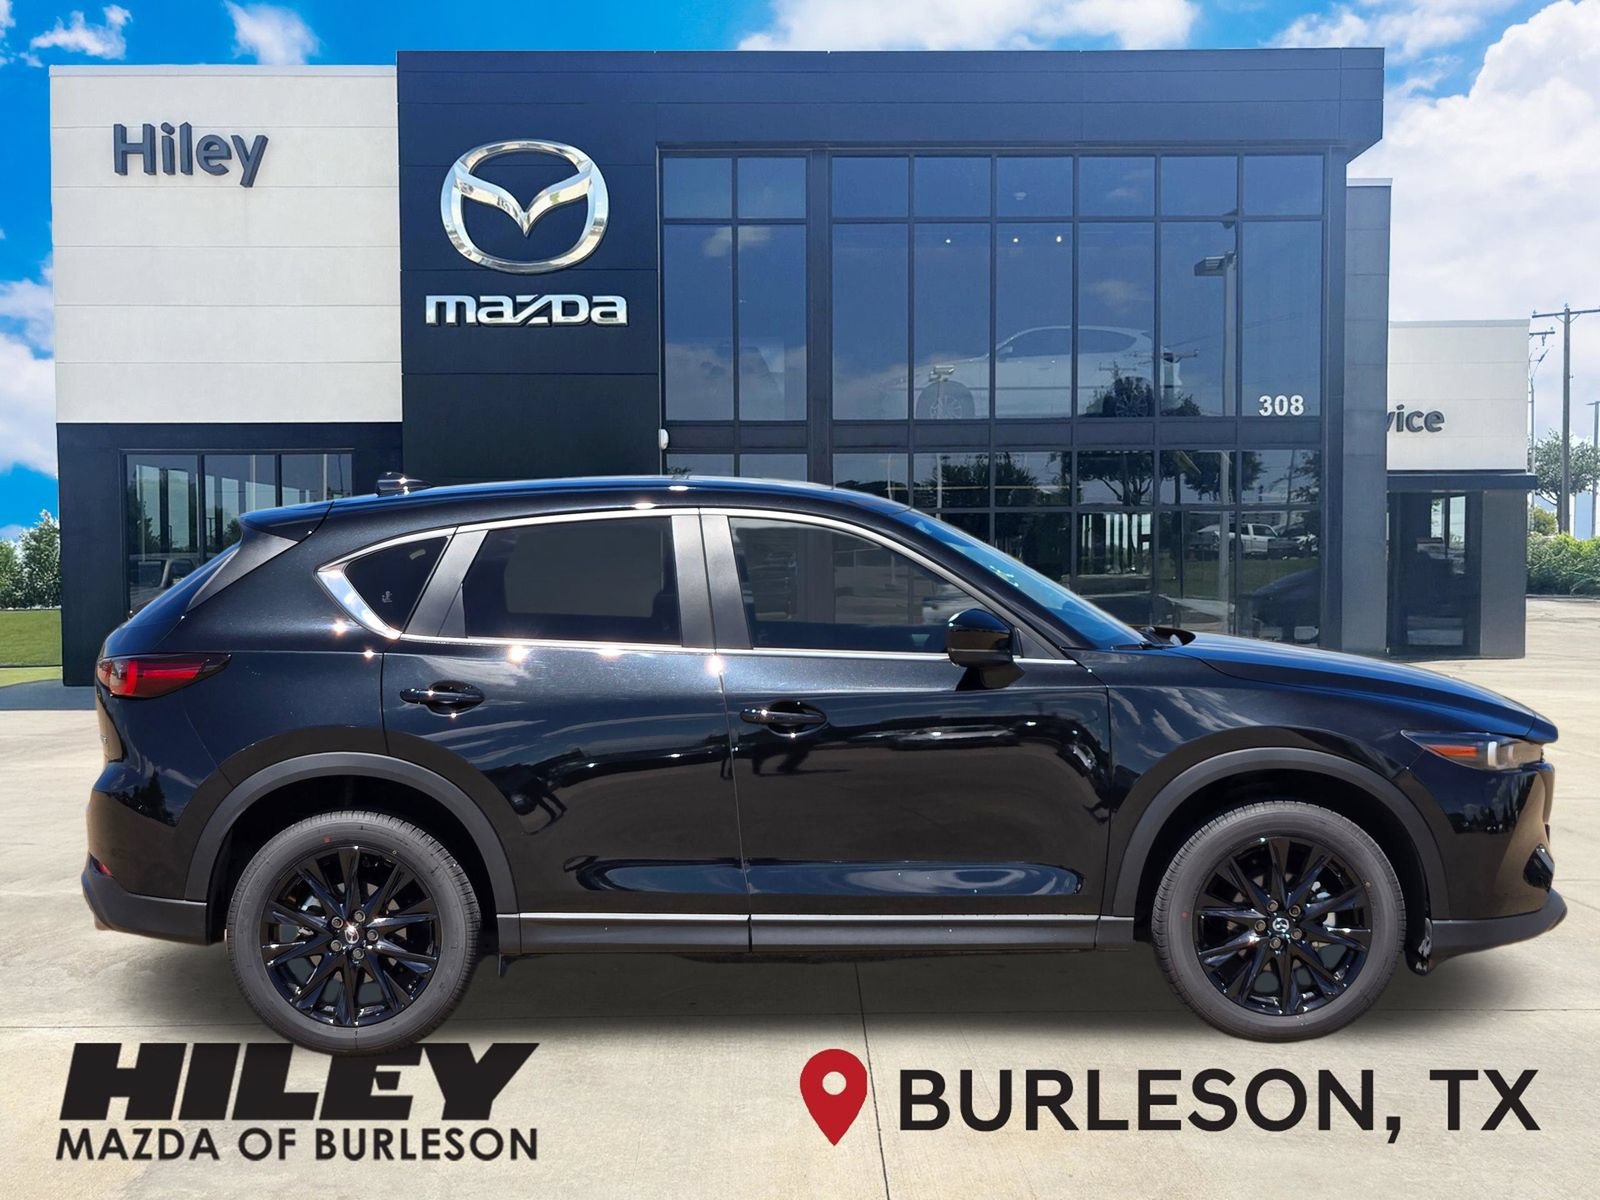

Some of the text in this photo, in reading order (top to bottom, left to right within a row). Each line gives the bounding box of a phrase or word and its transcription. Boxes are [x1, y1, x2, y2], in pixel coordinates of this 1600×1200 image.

[113, 122, 268, 188] Hiley
[425, 293, 628, 326] mazda
[1258, 395, 1304, 416] 308
